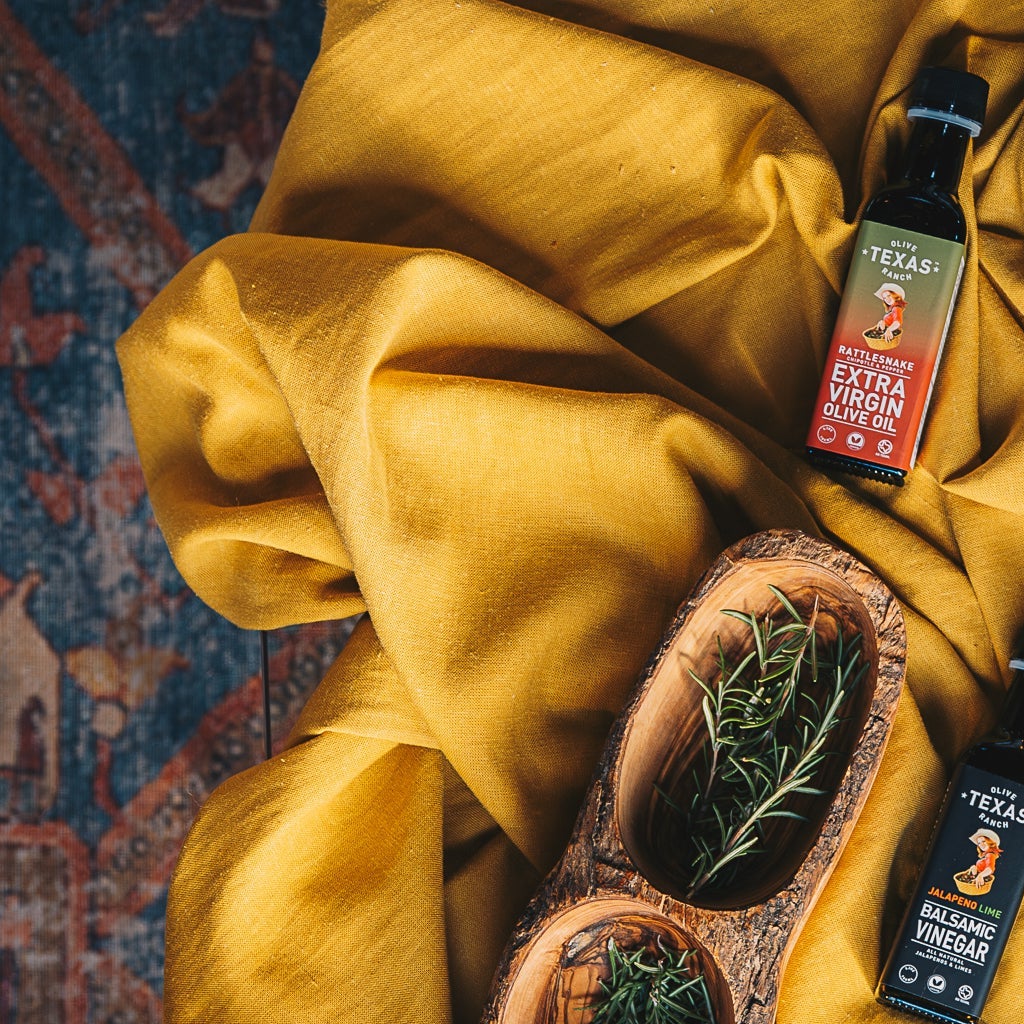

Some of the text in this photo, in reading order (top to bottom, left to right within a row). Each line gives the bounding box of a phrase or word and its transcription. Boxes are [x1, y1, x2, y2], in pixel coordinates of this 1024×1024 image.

[891, 240, 917, 252] OLIVE
[870, 246, 932, 274] TEXAS
[882, 268, 912, 280] RANCH
[838, 345, 914, 371] RATTLESNAKE
[847, 356, 874, 367] CHIPOTLE
[882, 365, 904, 374] PEPPER
[831, 363, 905, 398] EXTRA
[829, 383, 904, 418] VIRGIN
[823, 402, 896, 432] OLIVE OIL
[991, 786, 1018, 800] OLIVE
[979, 813, 1008, 828] RANCH
[928, 887, 1002, 919] JALAPENO LIME
[920, 903, 995, 940] BALSAMIC
[916, 920, 989, 962] VINEGAR
[915, 951, 947, 965] JALAPENOS
[955, 964, 972, 973] LIMES
[939, 953, 964, 965] NATURAL
